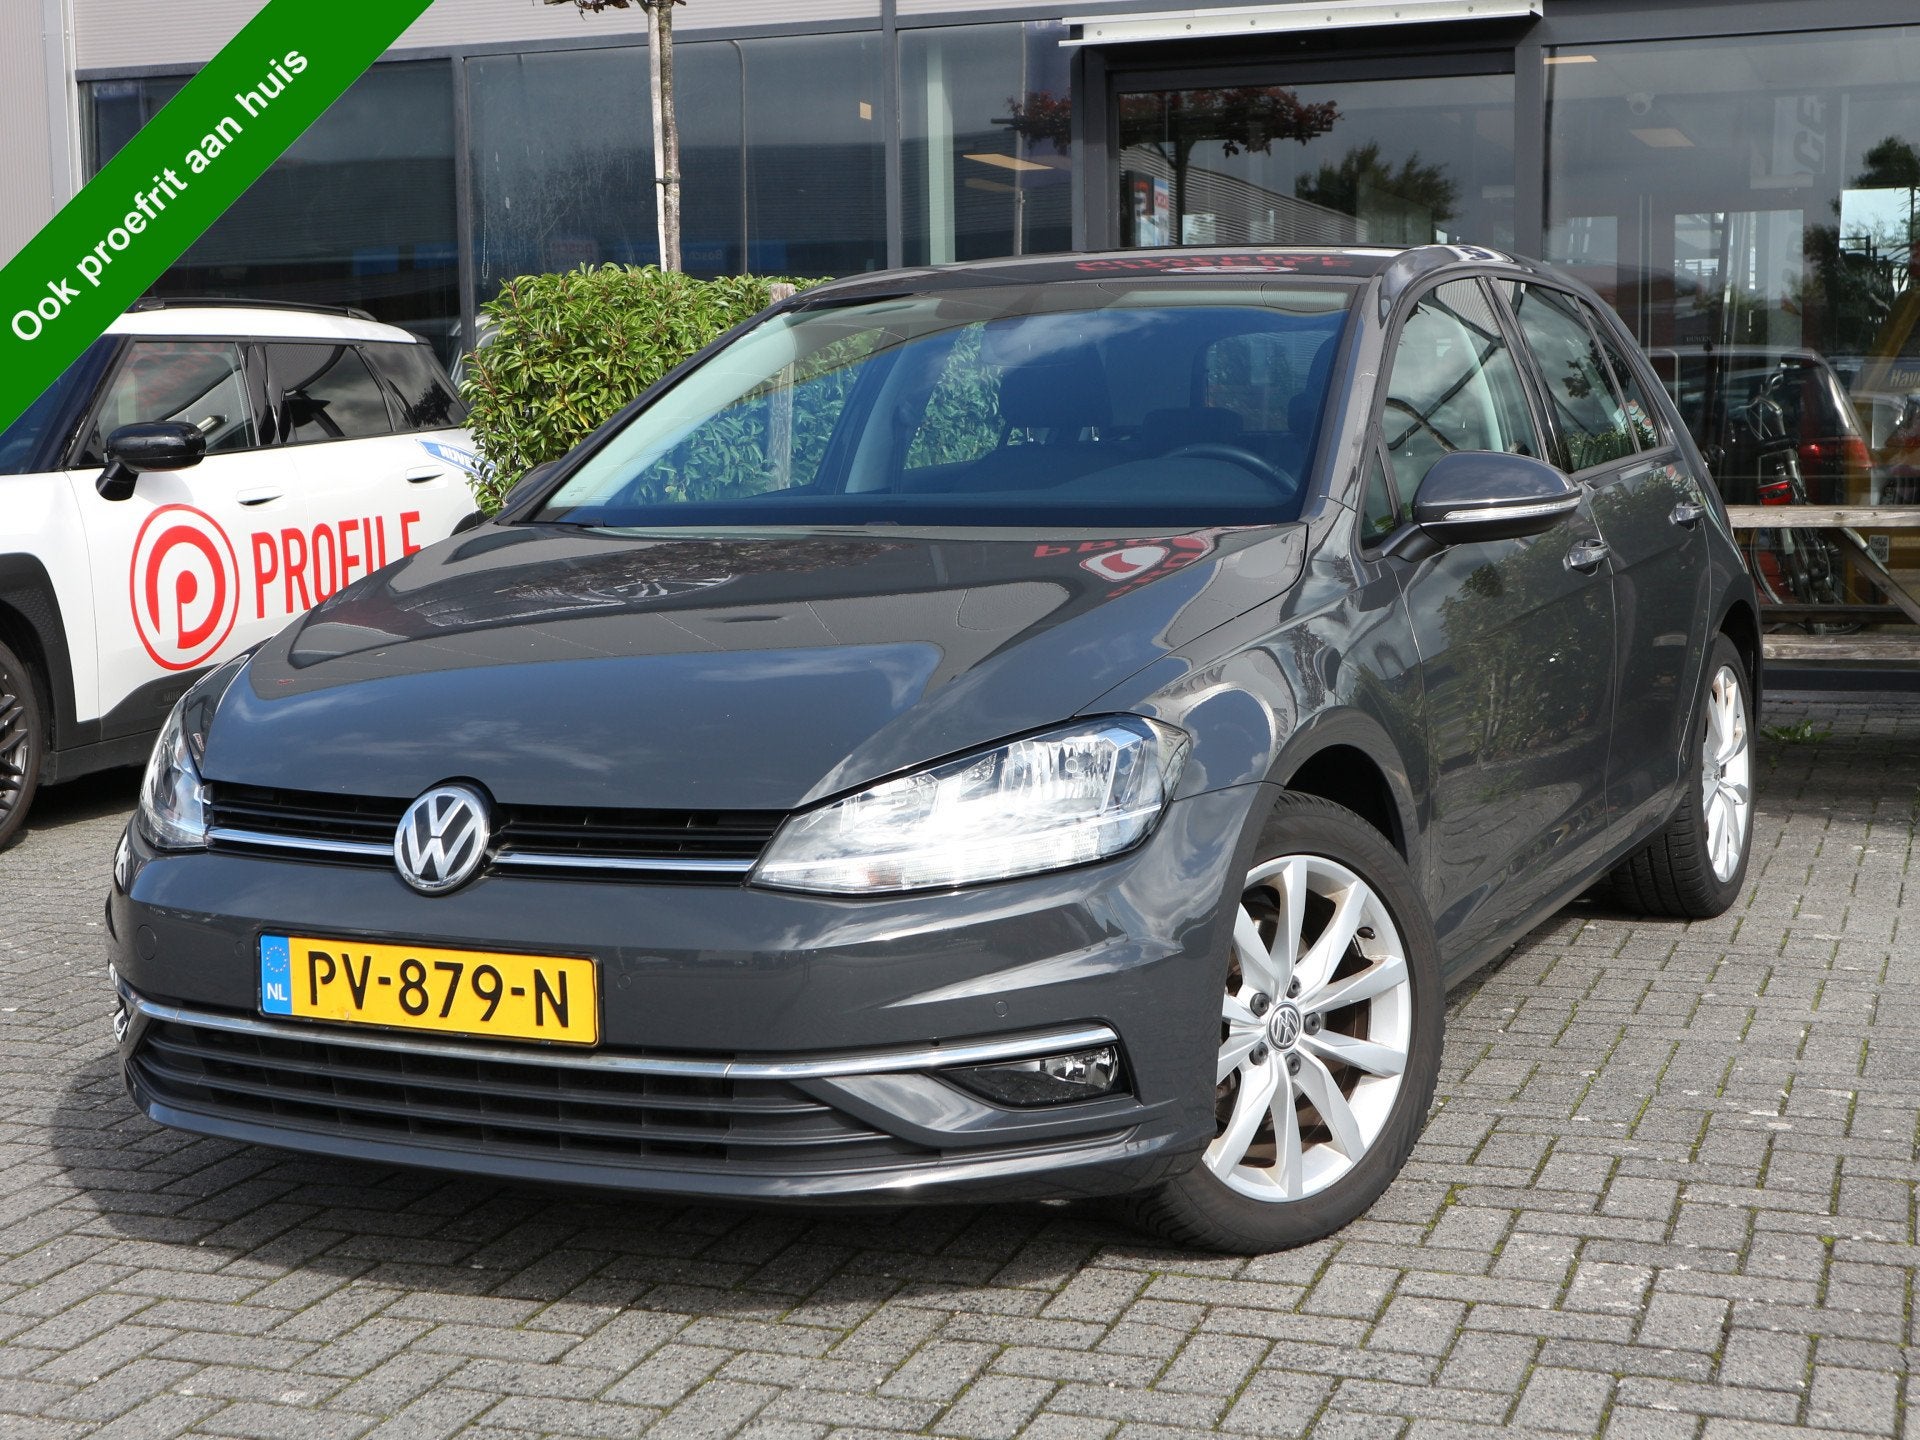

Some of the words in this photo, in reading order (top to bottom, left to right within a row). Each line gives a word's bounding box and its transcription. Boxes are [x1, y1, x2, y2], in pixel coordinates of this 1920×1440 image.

[1890, 368, 1920, 388] Hav
[266, 981, 288, 1002] NL
[307, 950, 570, 1029] PV-879-N
